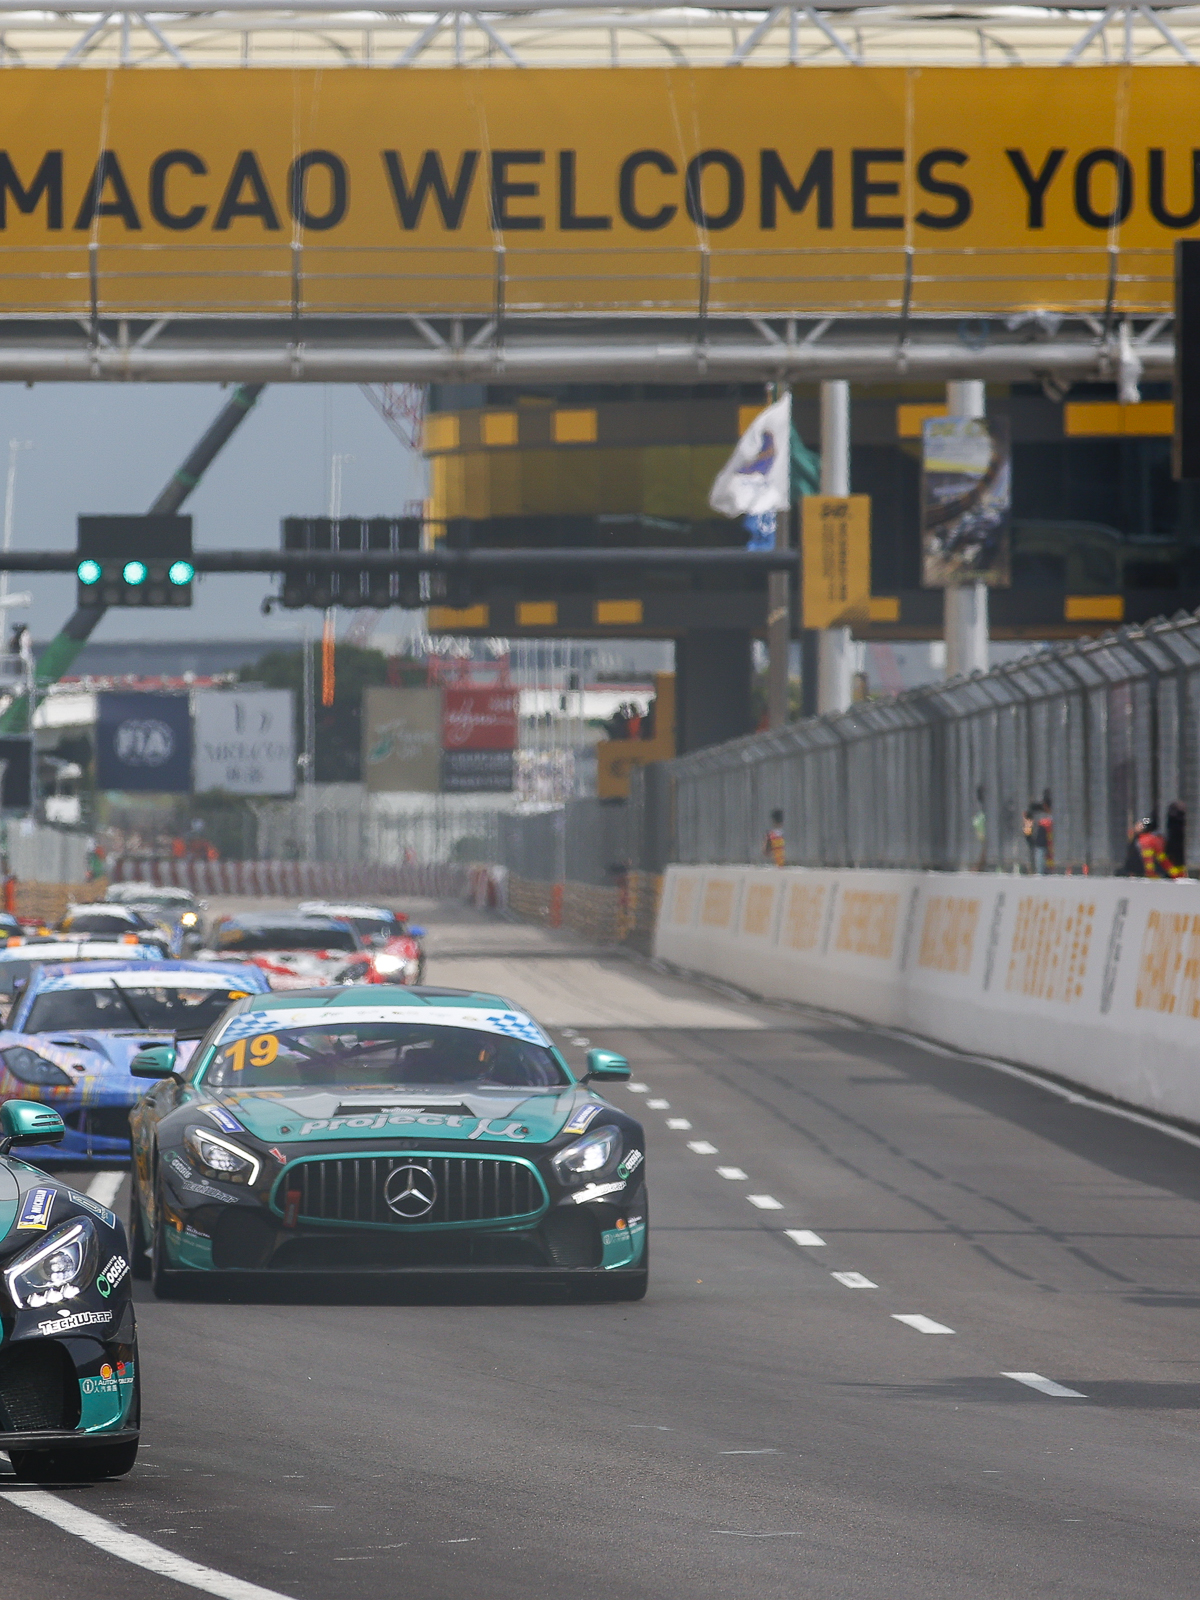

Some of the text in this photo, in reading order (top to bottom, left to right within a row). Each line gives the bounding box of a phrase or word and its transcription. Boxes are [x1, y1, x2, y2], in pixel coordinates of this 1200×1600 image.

[380, 147, 974, 232] WELCOMES
[1004, 147, 1200, 231] YOU
[224, 1033, 279, 1072] 19
[299, 1114, 465, 1136] project
[106, 1255, 127, 1284] oasis
